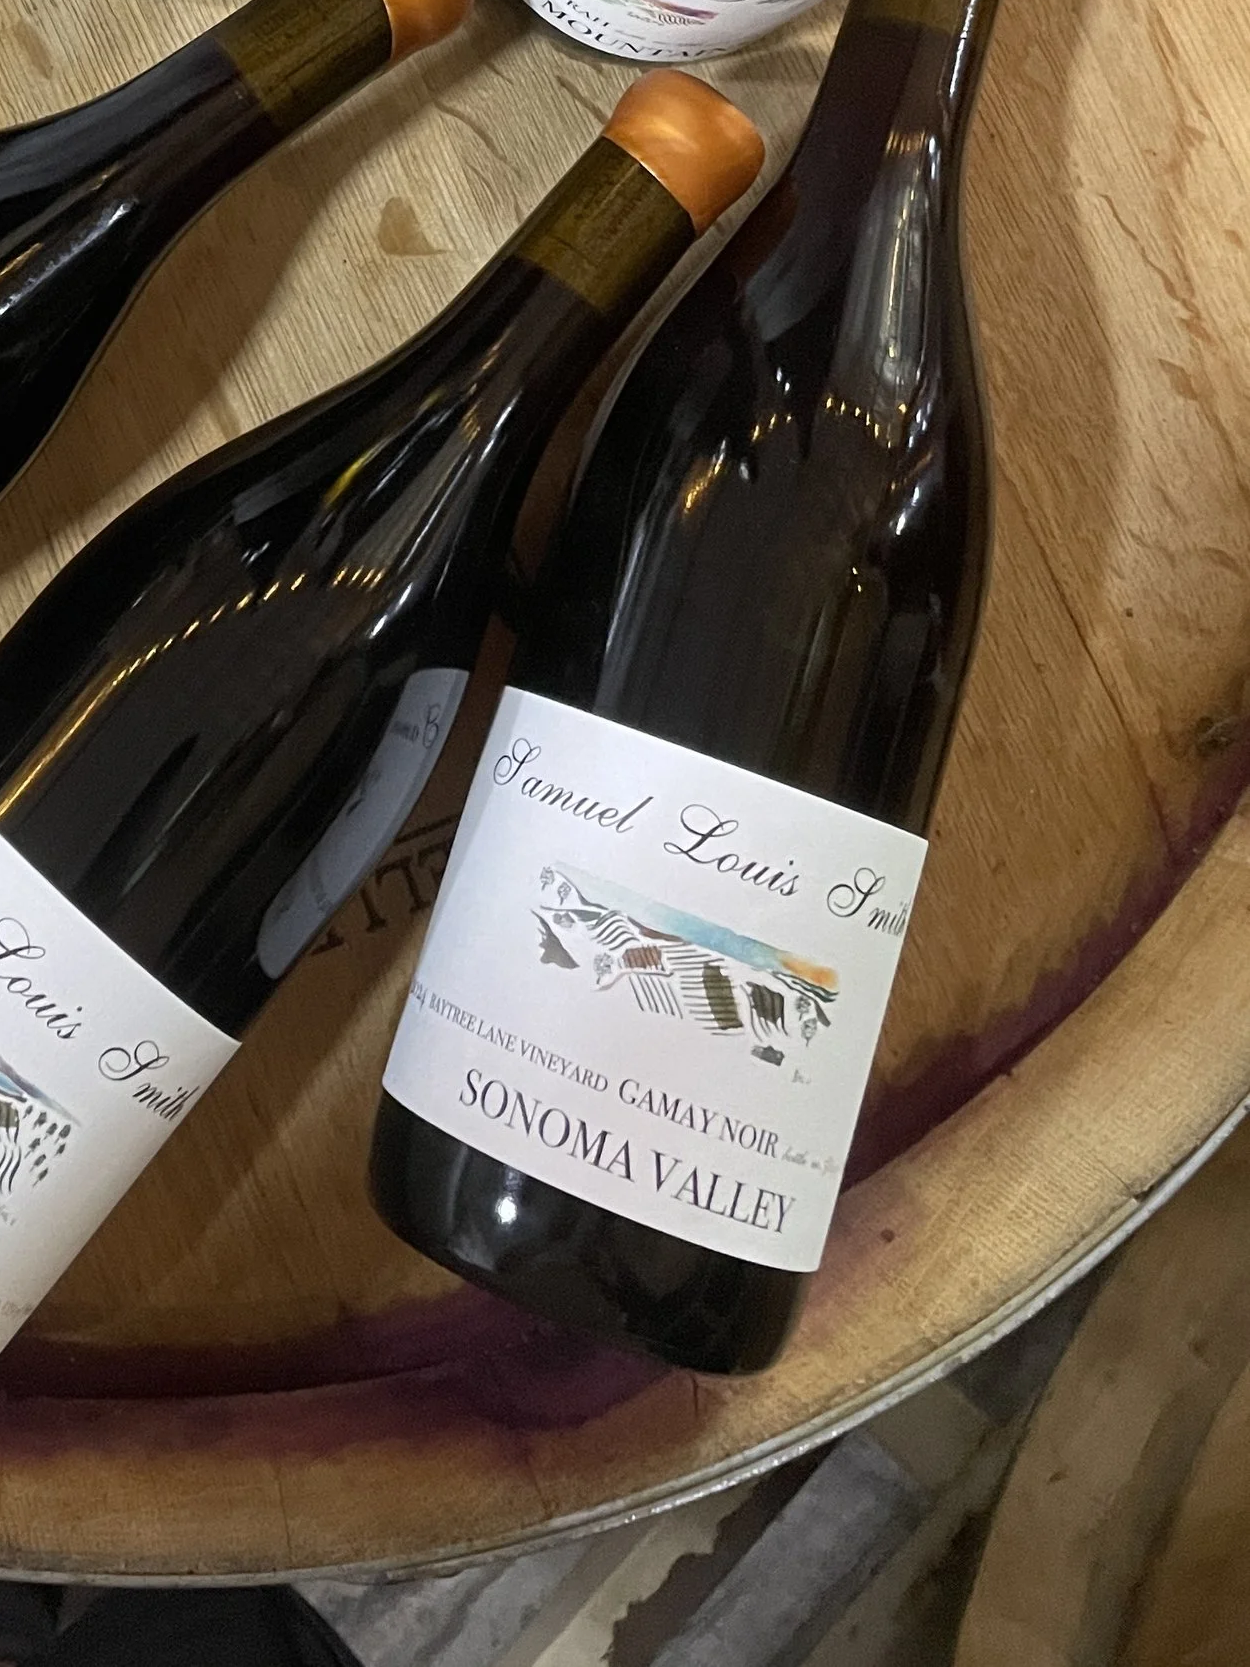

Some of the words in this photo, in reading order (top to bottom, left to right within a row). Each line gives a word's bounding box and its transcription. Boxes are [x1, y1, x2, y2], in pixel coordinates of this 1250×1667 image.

[493, 737, 654, 833] Samuel
[663, 804, 799, 897] Louis
[98, 1039, 200, 1122] Smith
[428, 993, 478, 1033] BAYTREE
[474, 1019, 518, 1052] LANE
[520, 1038, 610, 1093] VINEYARD
[618, 1077, 722, 1136] GAMAY
[718, 1115, 780, 1159] NOIR
[458, 1068, 636, 1183] SONOMA
[650, 1148, 799, 1235] VALLEY
